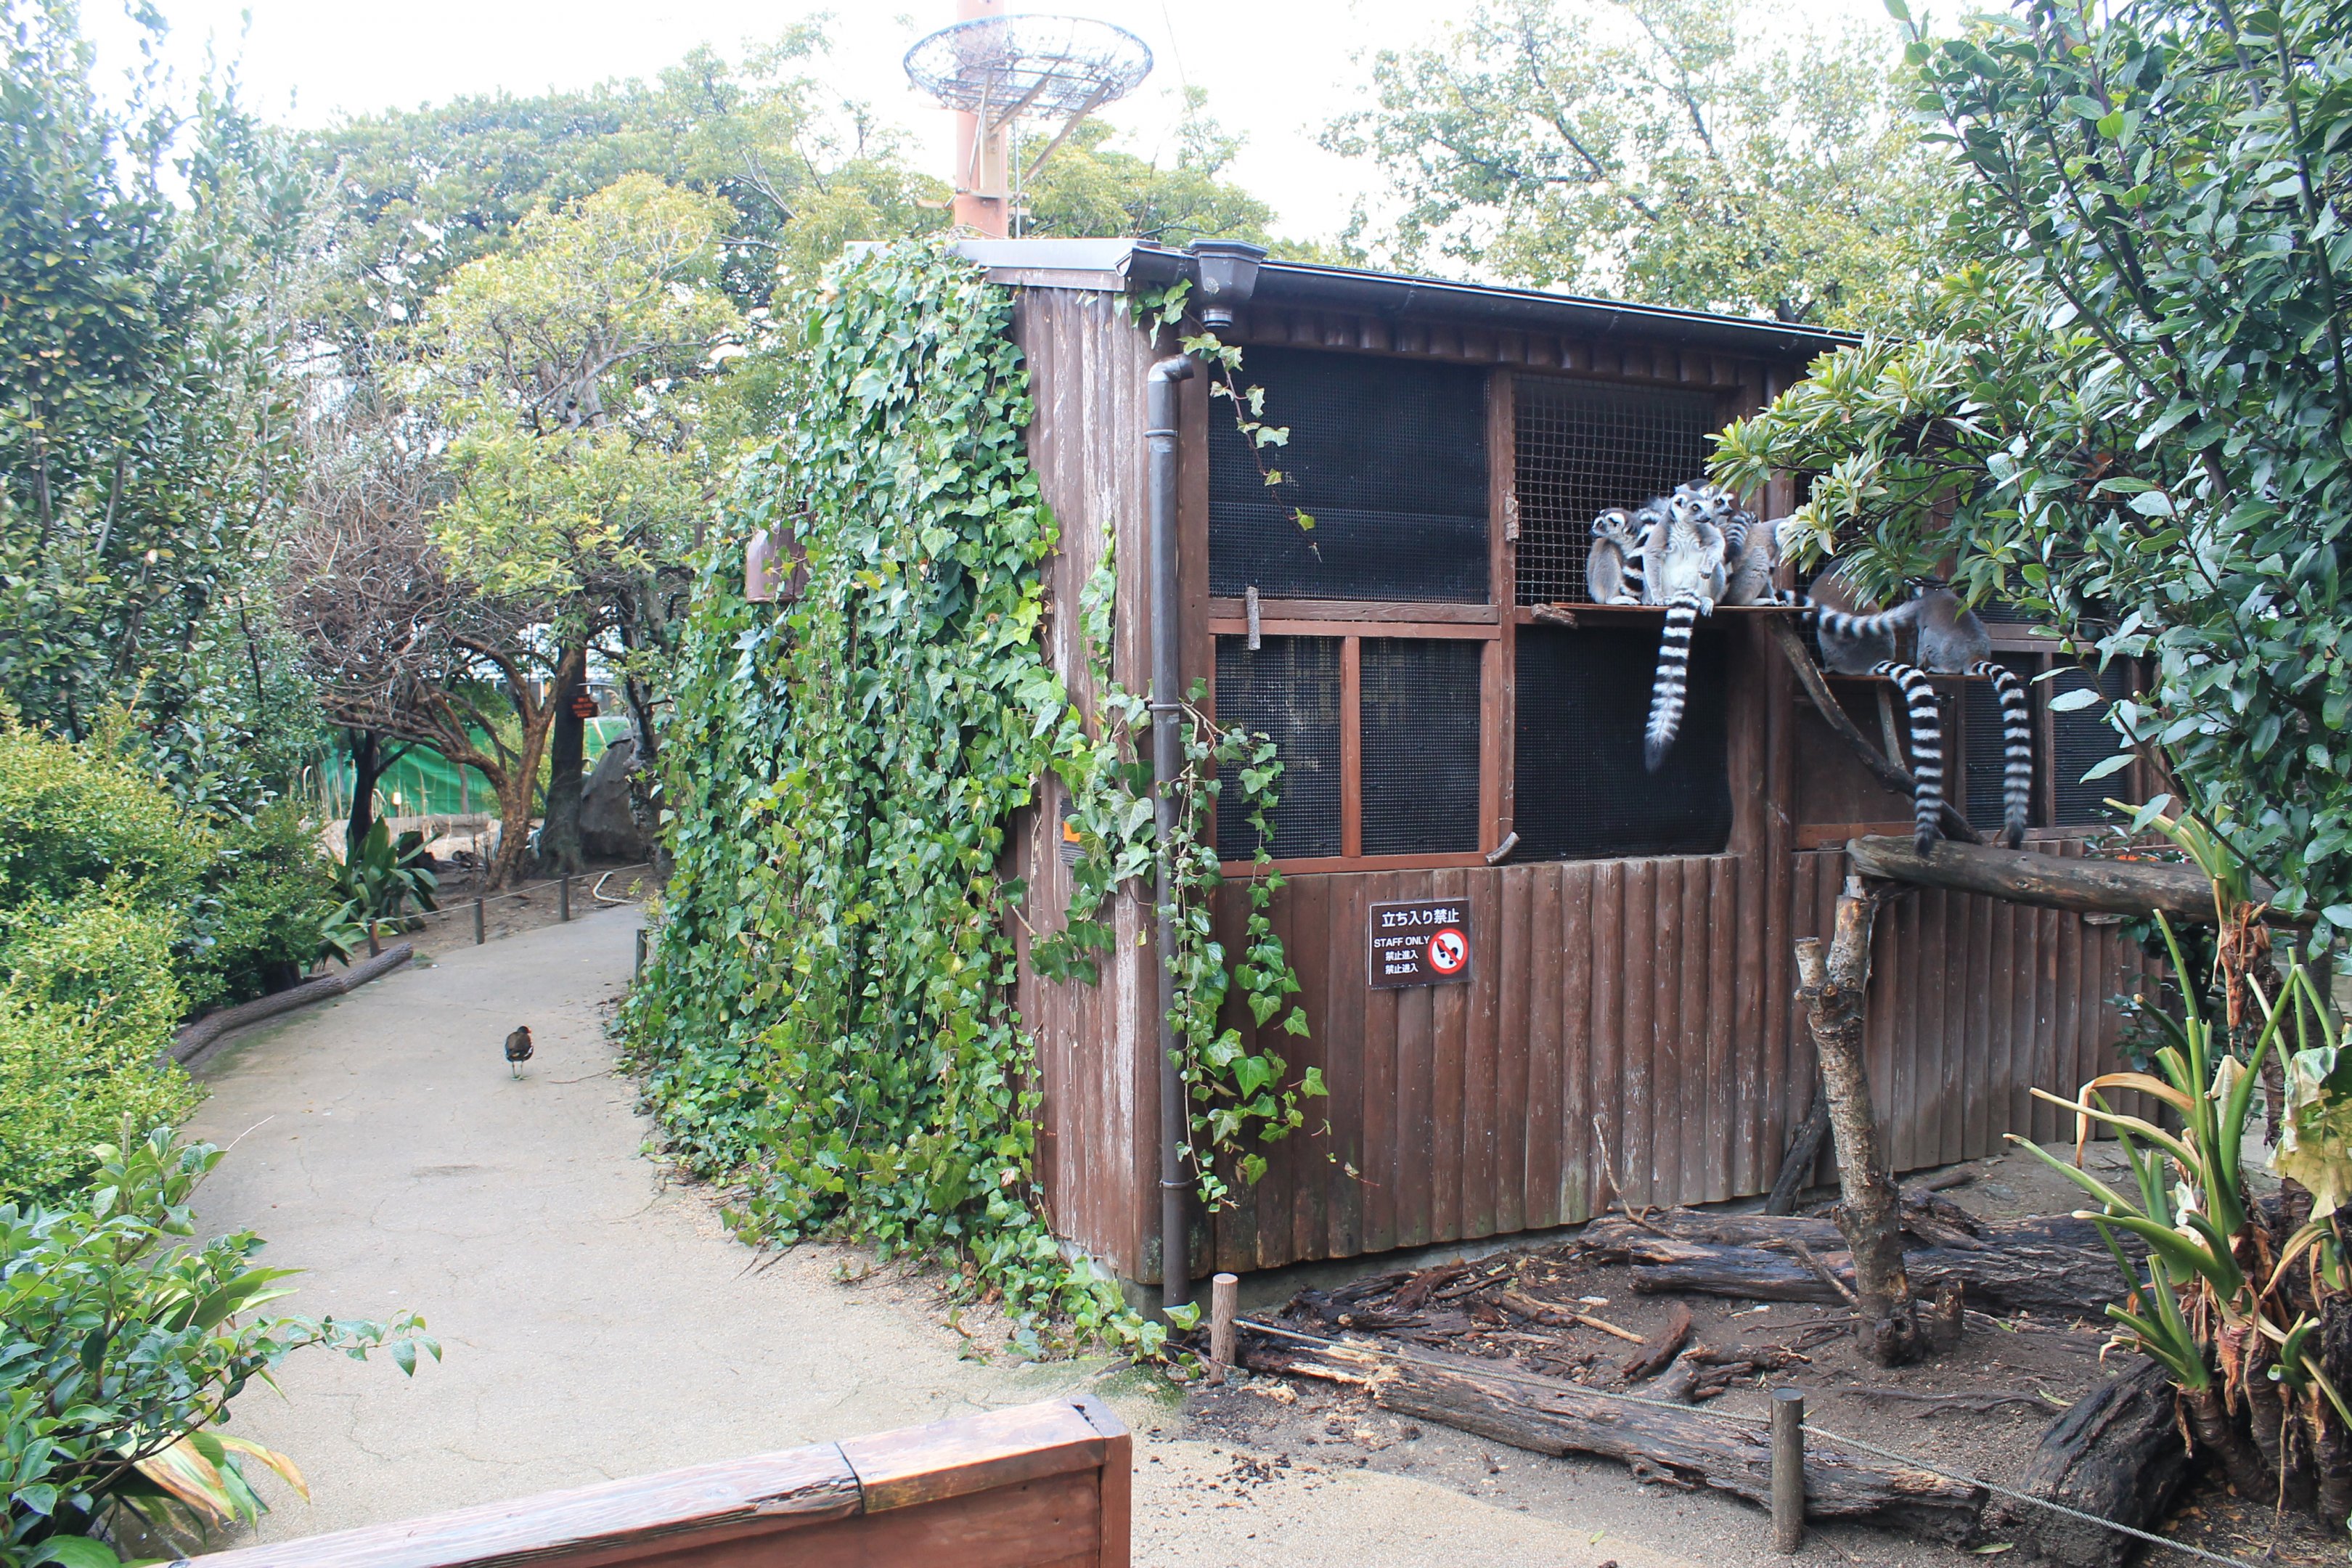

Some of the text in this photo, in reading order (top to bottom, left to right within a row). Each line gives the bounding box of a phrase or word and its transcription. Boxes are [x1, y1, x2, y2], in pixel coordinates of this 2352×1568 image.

[1381, 907, 1460, 928] 立ち入り禁止
[1373, 935, 1430, 948] STAFF ONLY
[1385, 950, 1418, 962] 禁止進入
